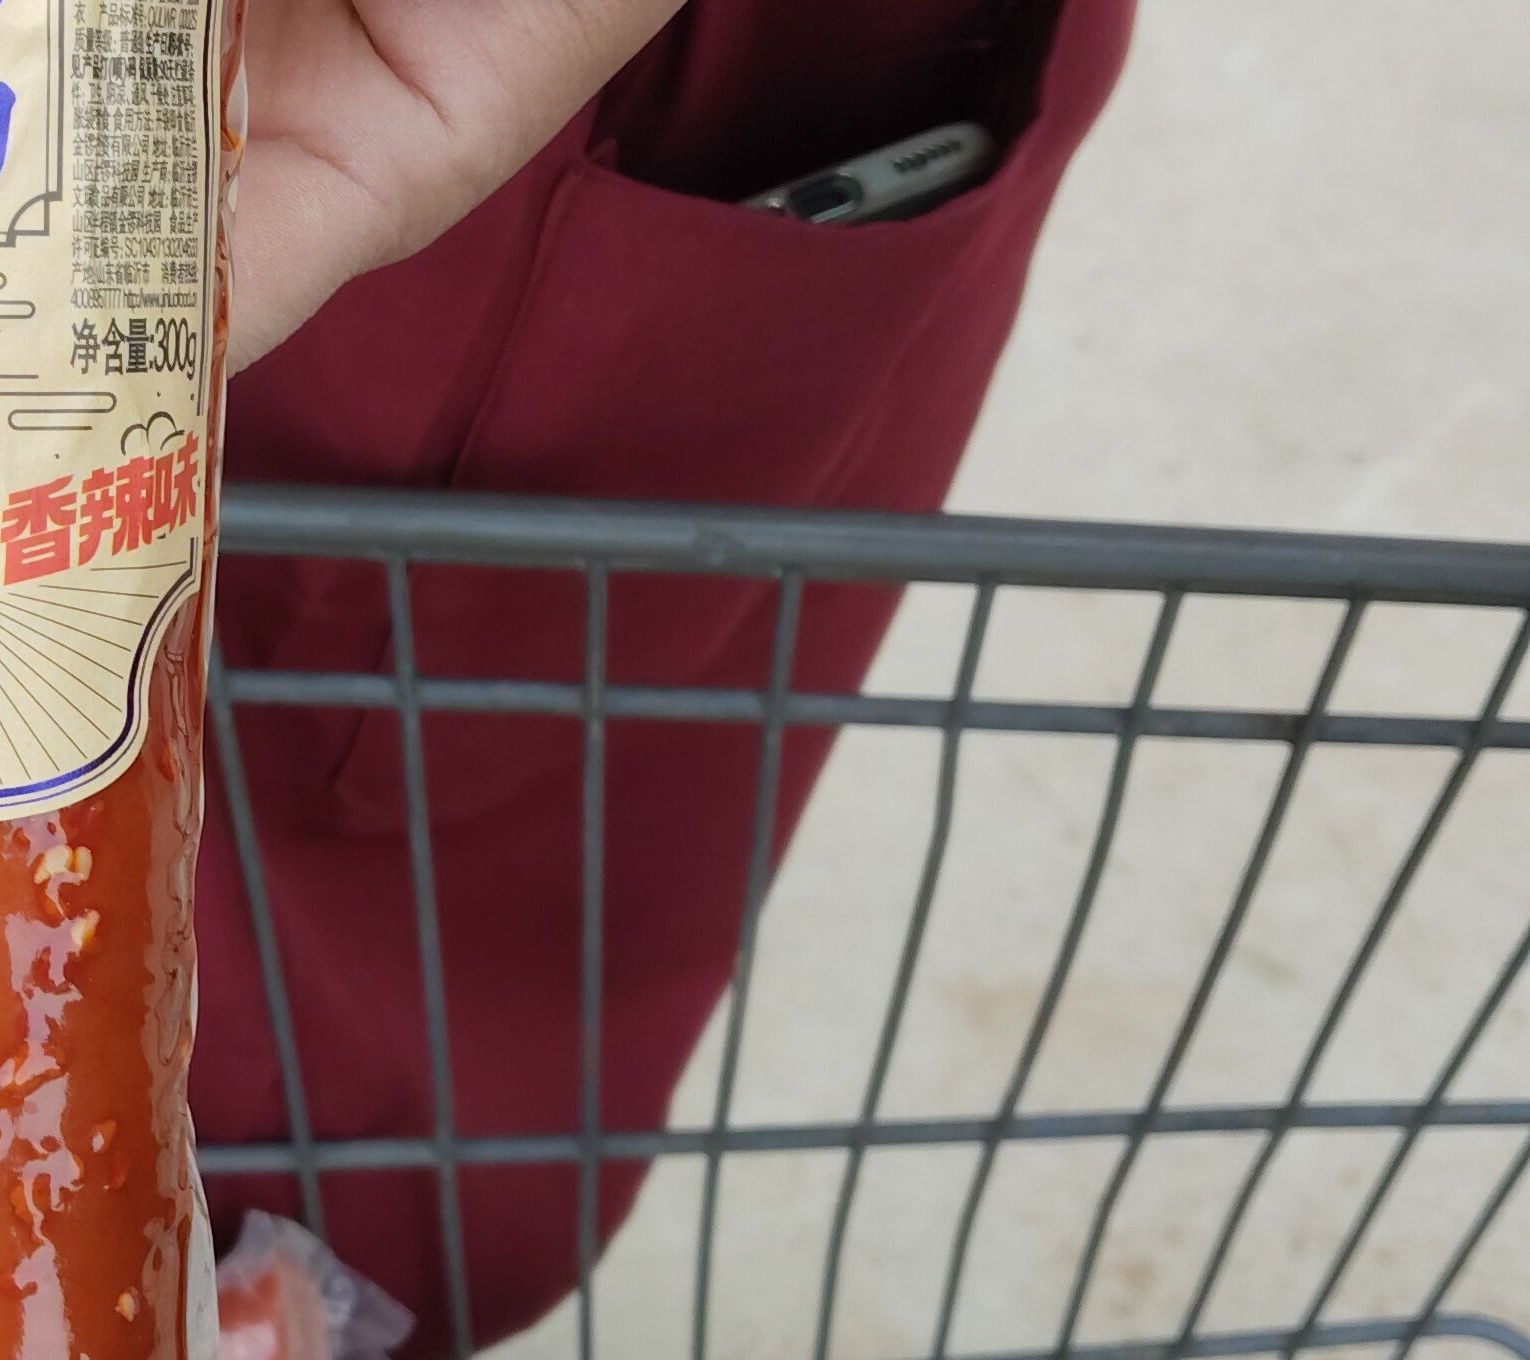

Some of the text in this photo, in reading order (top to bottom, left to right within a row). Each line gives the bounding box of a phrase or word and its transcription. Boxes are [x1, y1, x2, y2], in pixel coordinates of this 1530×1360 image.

[69, 317, 197, 381] 净含量:300g
[1, 430, 200, 586] 香辣味
